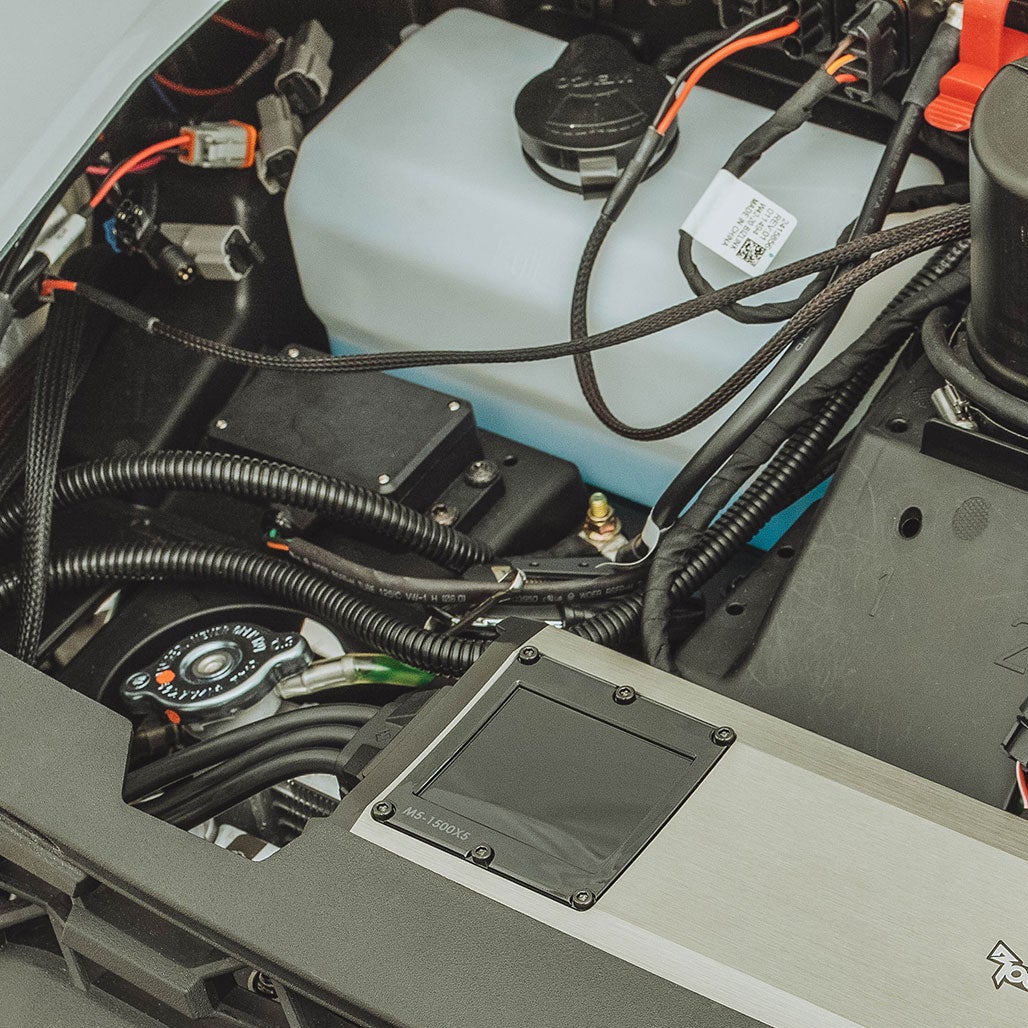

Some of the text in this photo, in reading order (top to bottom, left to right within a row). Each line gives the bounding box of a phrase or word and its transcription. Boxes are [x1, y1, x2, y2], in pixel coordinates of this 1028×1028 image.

[721, 198, 758, 247] MADE IN CHINA
[402, 806, 471, 841] M5-1500X5
